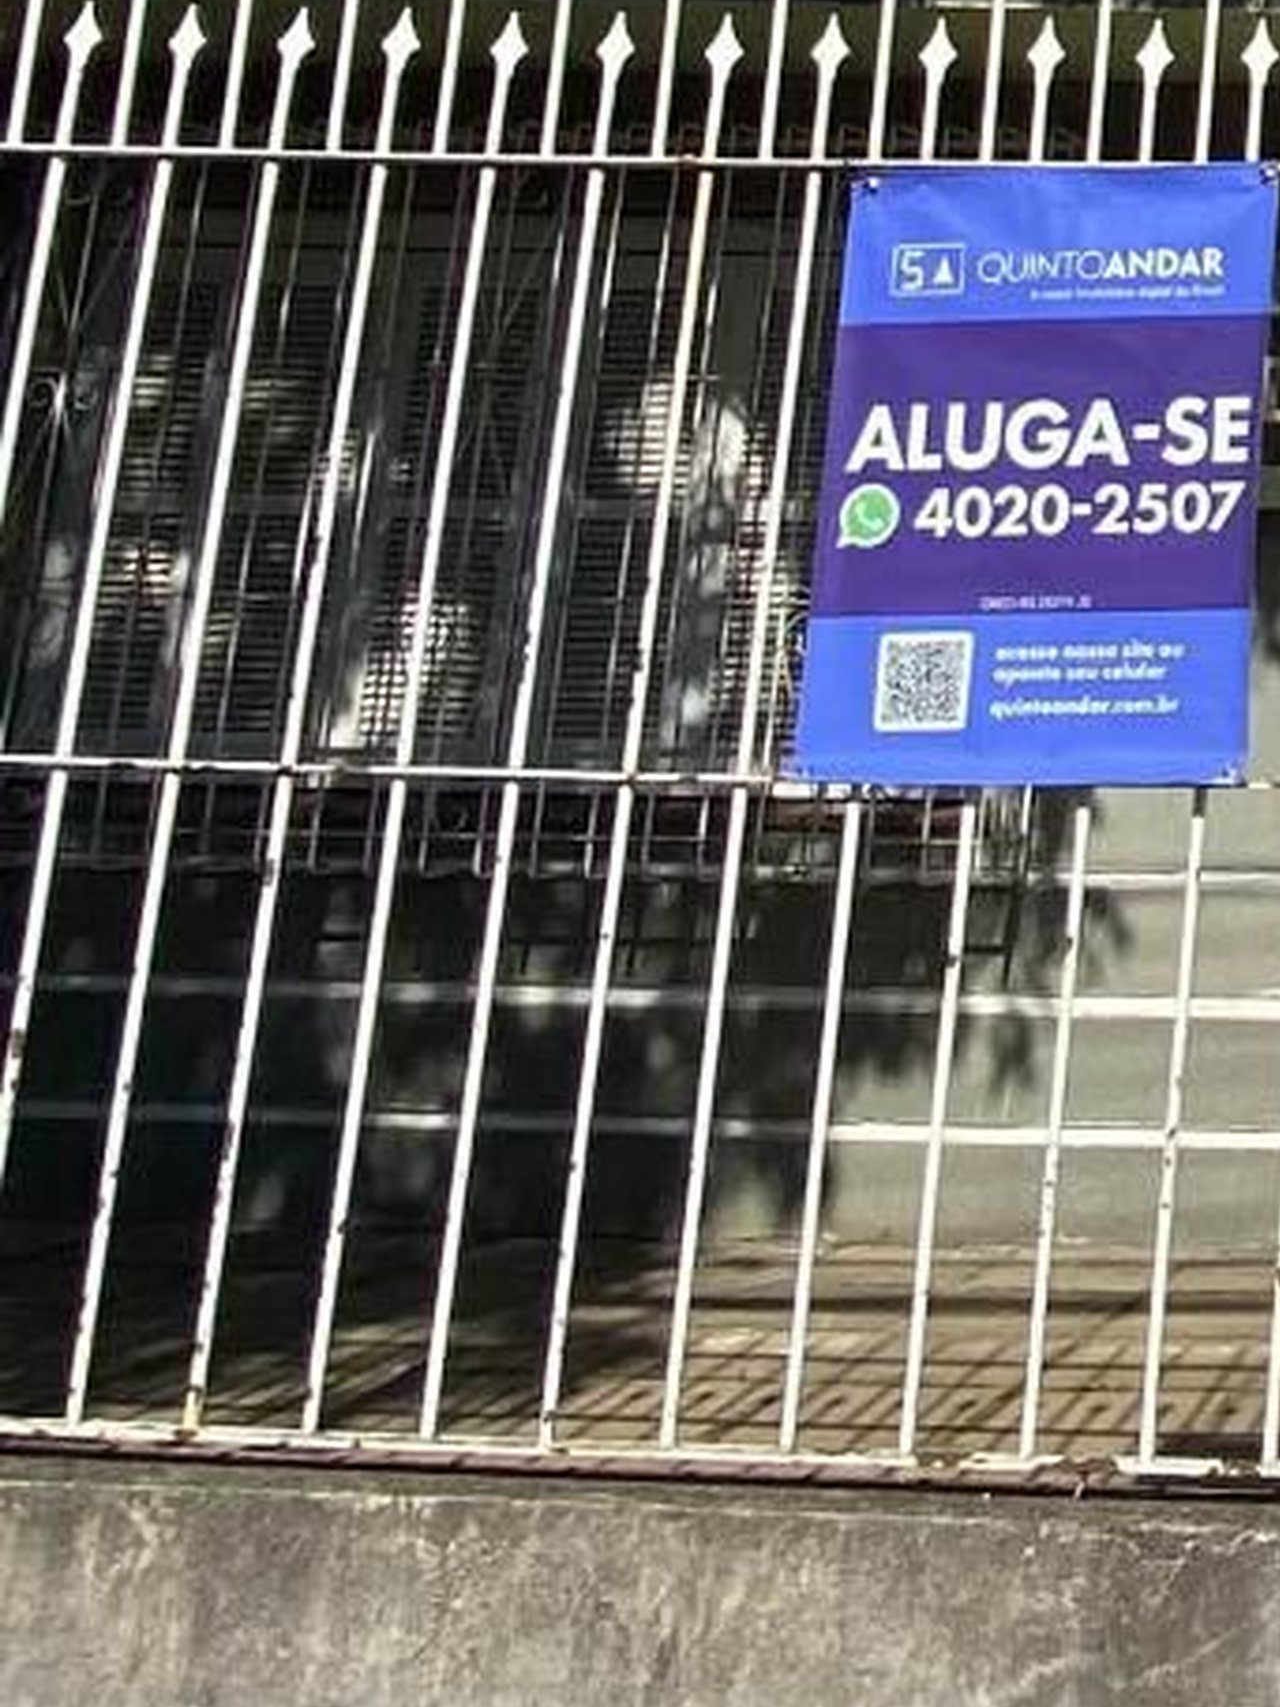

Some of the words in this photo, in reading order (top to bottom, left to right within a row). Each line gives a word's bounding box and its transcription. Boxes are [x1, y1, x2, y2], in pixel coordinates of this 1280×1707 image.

[977, 247, 1224, 283] QUINTOANDAR
[844, 396, 1252, 473] ALUGA-SE
[913, 481, 1246, 538] 4020-2507
[989, 694, 1180, 720] quintoandar.com.br
